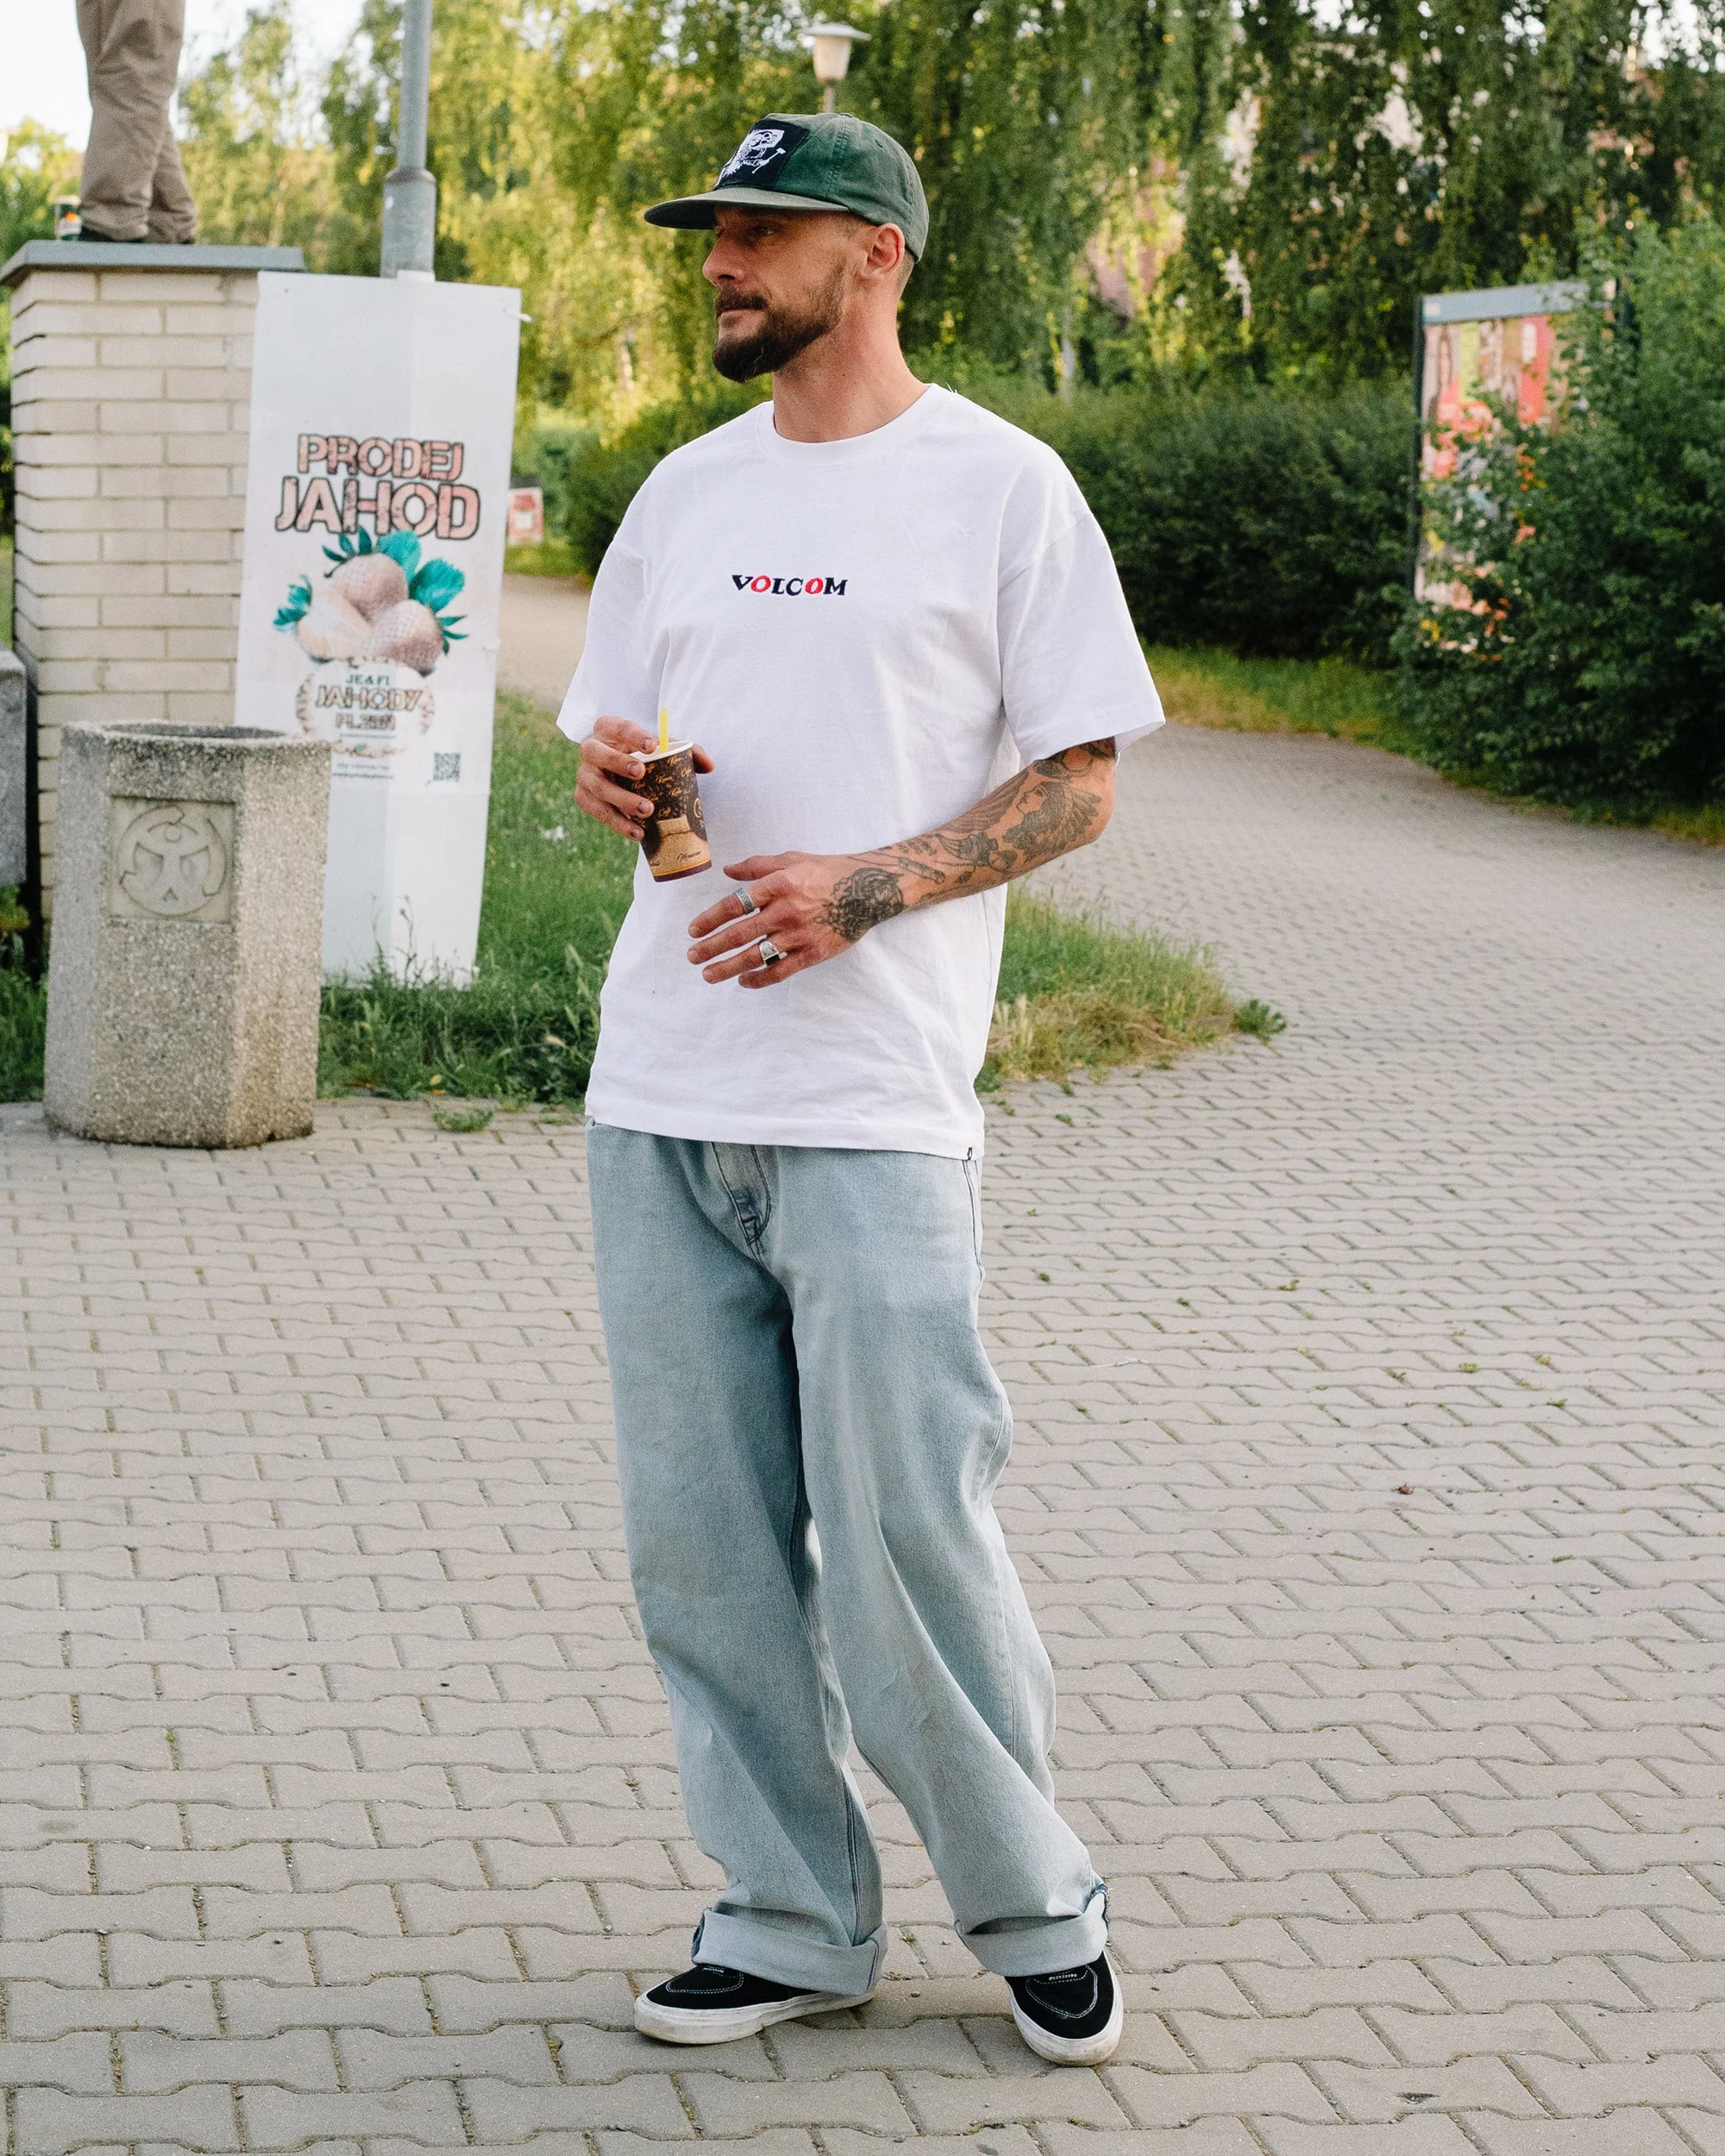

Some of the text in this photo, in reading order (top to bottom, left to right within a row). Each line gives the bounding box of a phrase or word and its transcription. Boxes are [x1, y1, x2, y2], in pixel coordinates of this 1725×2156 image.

[298, 433, 464, 481] PRODEJ
[274, 475, 481, 540] JAHOD
[732, 574, 848, 596] VOLCOM
[315, 685, 423, 711] JAHODY
